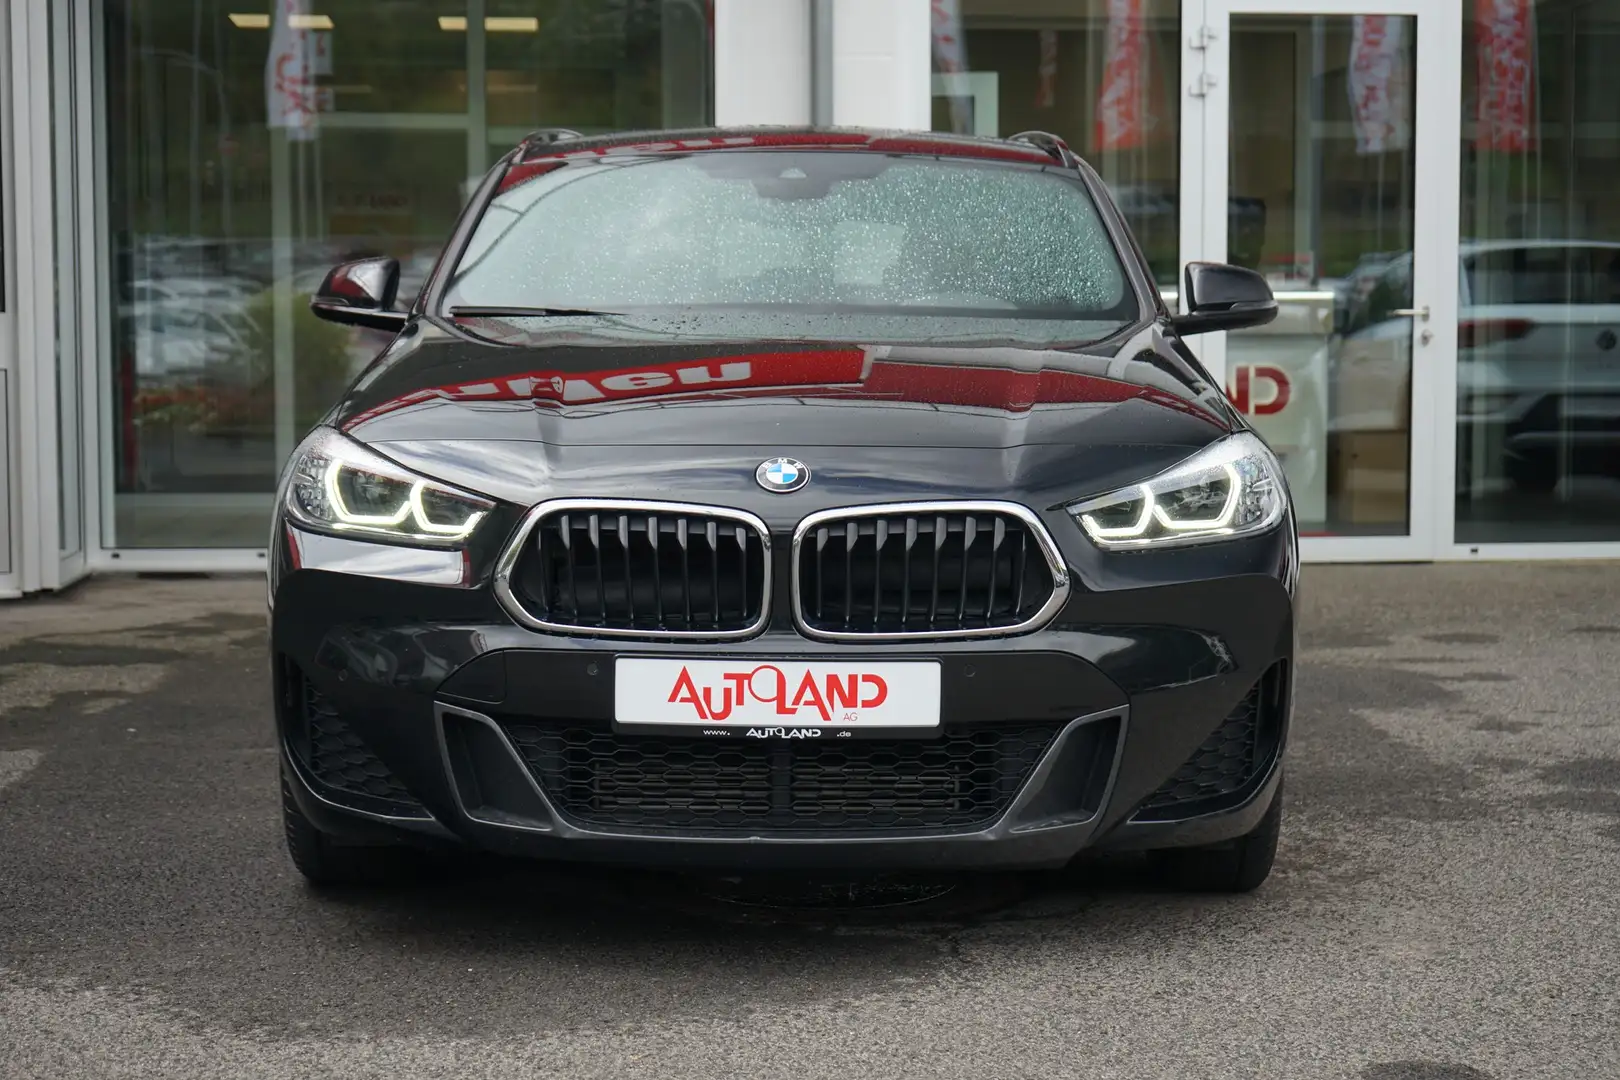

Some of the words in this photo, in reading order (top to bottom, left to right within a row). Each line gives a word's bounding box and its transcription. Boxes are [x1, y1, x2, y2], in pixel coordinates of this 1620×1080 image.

[668, 665, 888, 721] AUTOLAND
[843, 712, 858, 722] AG
[746, 726, 822, 739] AUTOLAND
